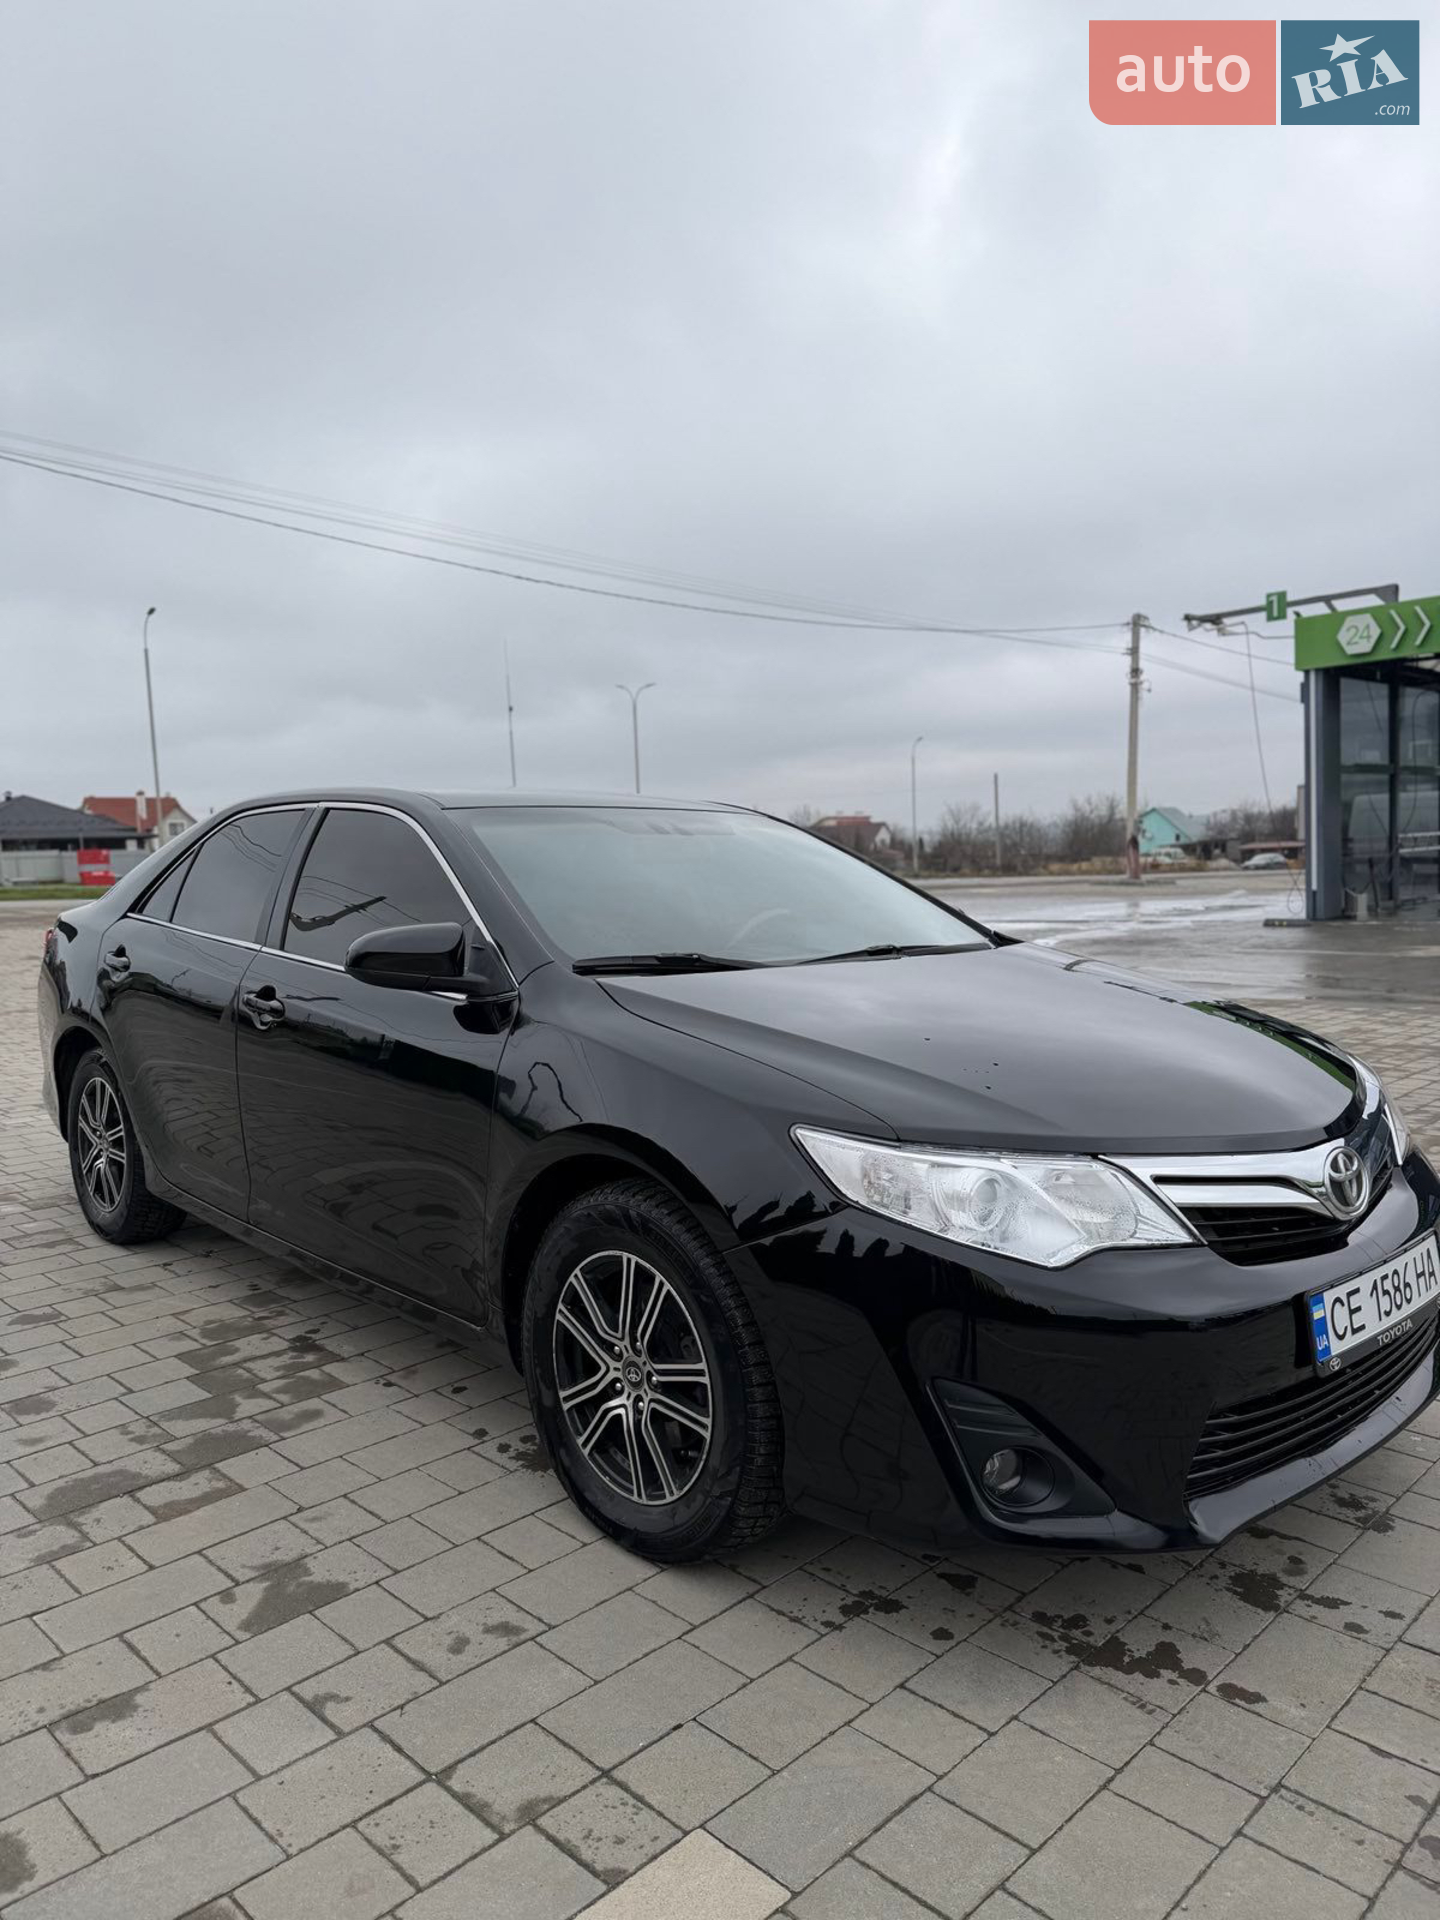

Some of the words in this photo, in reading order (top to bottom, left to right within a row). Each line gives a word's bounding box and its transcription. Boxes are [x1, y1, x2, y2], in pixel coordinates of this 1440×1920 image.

[1268, 595, 1278, 618] 1
[1345, 623, 1372, 646] 24
[1331, 1286, 1366, 1341] CE
[1369, 1261, 1413, 1322] 1586
[1413, 1247, 1438, 1298] HA
[1316, 1333, 1329, 1351] UA
[1376, 1318, 1413, 1346] TOYOTA
